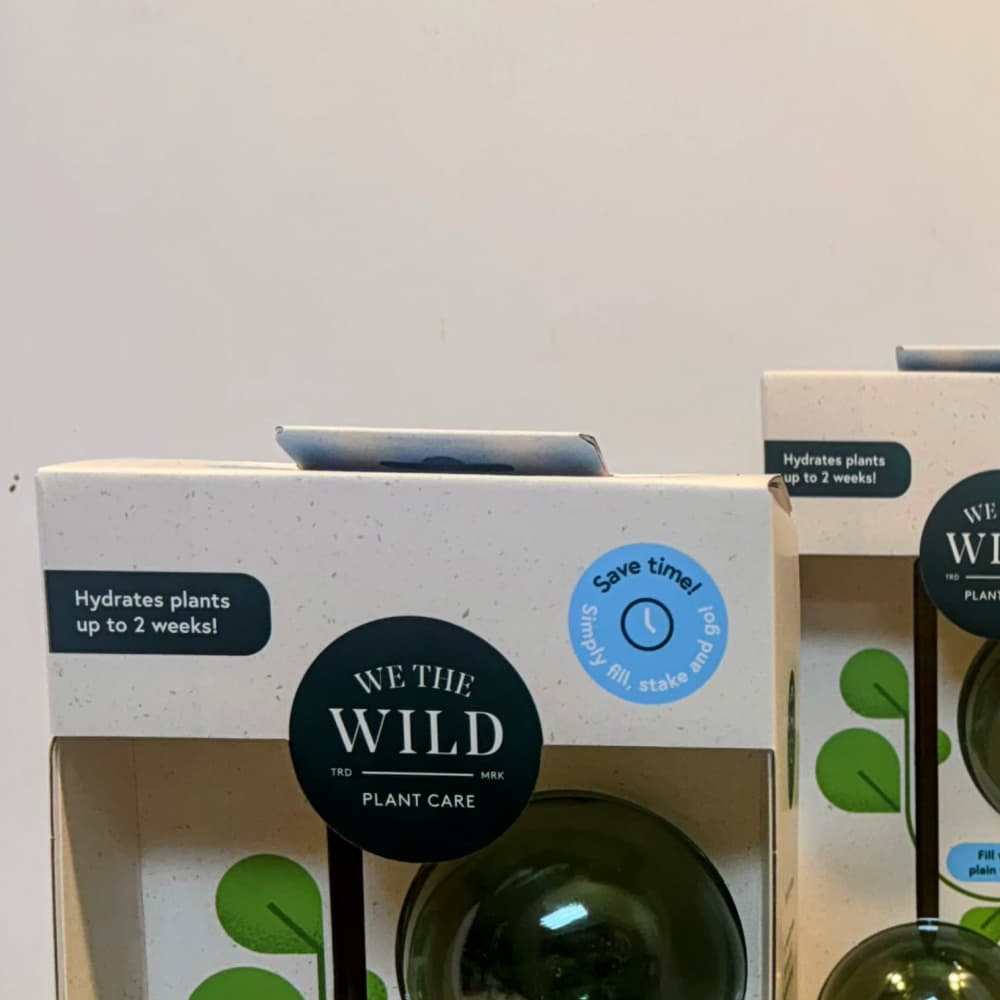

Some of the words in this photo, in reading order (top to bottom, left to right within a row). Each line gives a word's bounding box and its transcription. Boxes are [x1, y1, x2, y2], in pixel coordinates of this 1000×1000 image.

[784, 453, 842, 469] Hydrates
[846, 454, 885, 470] plants
[784, 474, 800, 486] up
[804, 472, 817, 484] to
[822, 471, 829, 484] 2
[833, 472, 876, 484] weeks!
[963, 502, 997, 524] WE
[593, 560, 641, 593] Save
[648, 556, 702, 596] time!
[75, 589, 164, 612] Hydrates
[170, 590, 230, 612] plants
[76, 619, 100, 637] up
[106, 618, 128, 633] to
[134, 616, 145, 633] 2
[152, 616, 218, 634] weeks!
[698, 605, 721, 636] go!
[580, 604, 607, 667] Simply
[690, 640, 713, 673] and
[353, 664, 406, 694] WE
[412, 664, 475, 698] THE
[607, 663, 632, 691] fill,
[639, 671, 688, 692] stake
[328, 708, 504, 756] WILD
[330, 768, 352, 777] TRD
[481, 771, 504, 780] MRK
[362, 792, 421, 808] PLANT
[428, 793, 476, 808] CARE
[977, 850, 995, 861] Fill
[968, 864, 996, 877] plain
